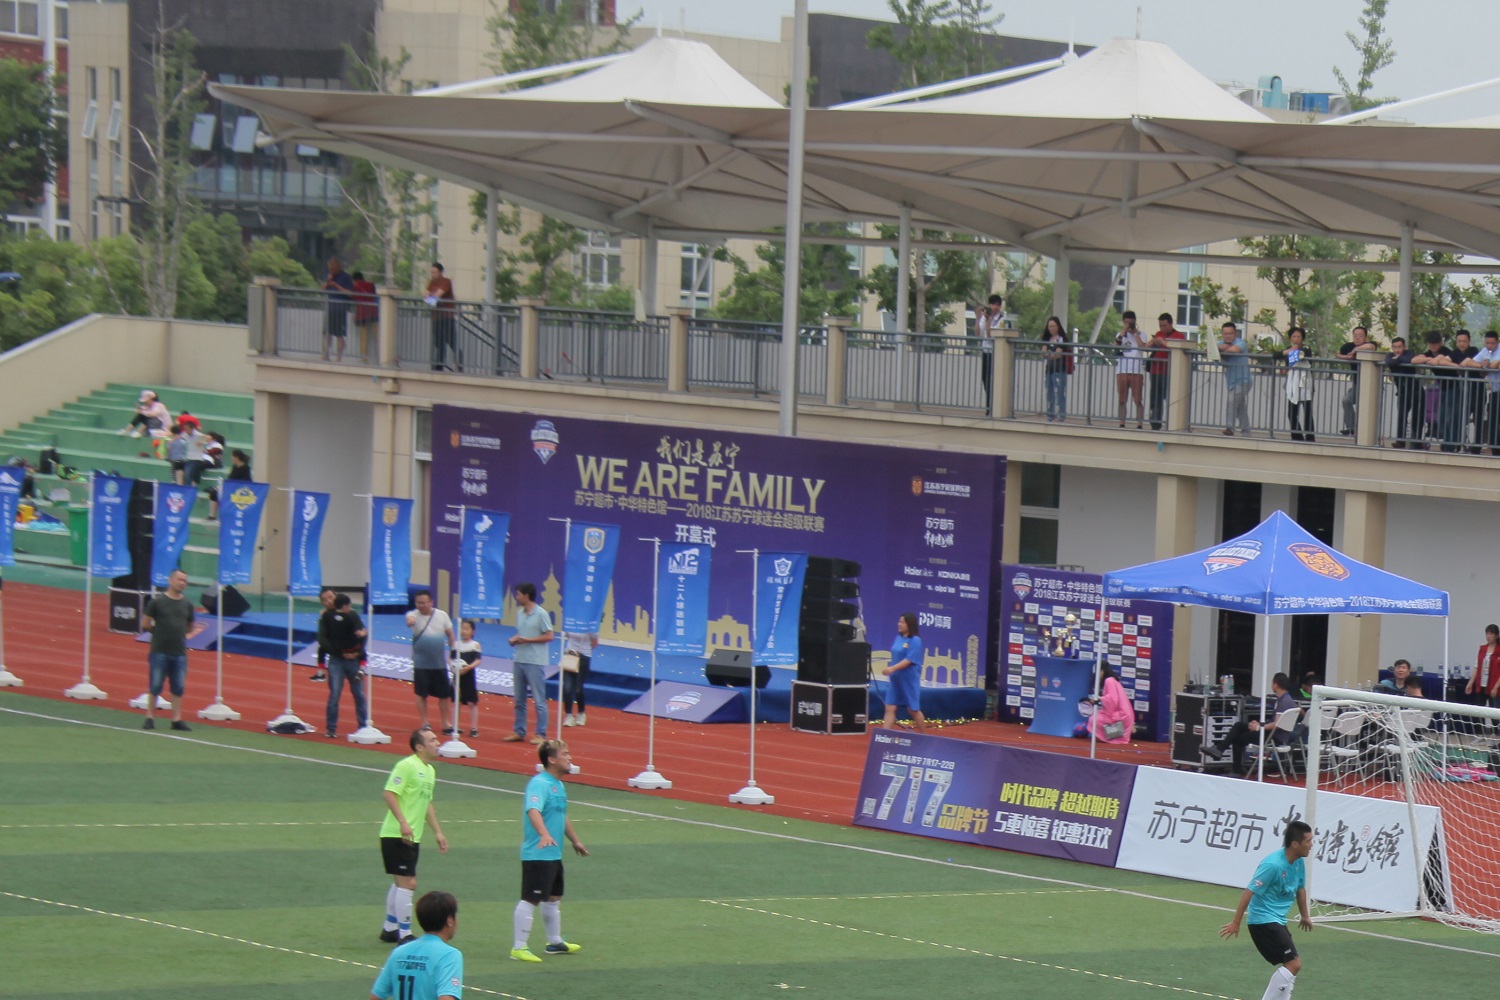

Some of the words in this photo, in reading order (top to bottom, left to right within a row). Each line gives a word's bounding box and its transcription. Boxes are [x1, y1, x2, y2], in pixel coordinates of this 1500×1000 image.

[656, 436, 740, 469] 我们是苏宁
[576, 454, 628, 493] WE
[633, 461, 699, 501] ARE
[706, 468, 826, 514] FAMILY
[675, 523, 717, 548] 开幕式
[876, 761, 954, 828] 717
[937, 803, 990, 834] 品牌节
[1000, 782, 1060, 811] 时代品牌
[1059, 791, 1120, 820] 超越期待
[993, 811, 1052, 840] 5重惊喜
[1051, 819, 1113, 850] 钜惠狂欢
[1147, 800, 1267, 853] 苏宁超市
